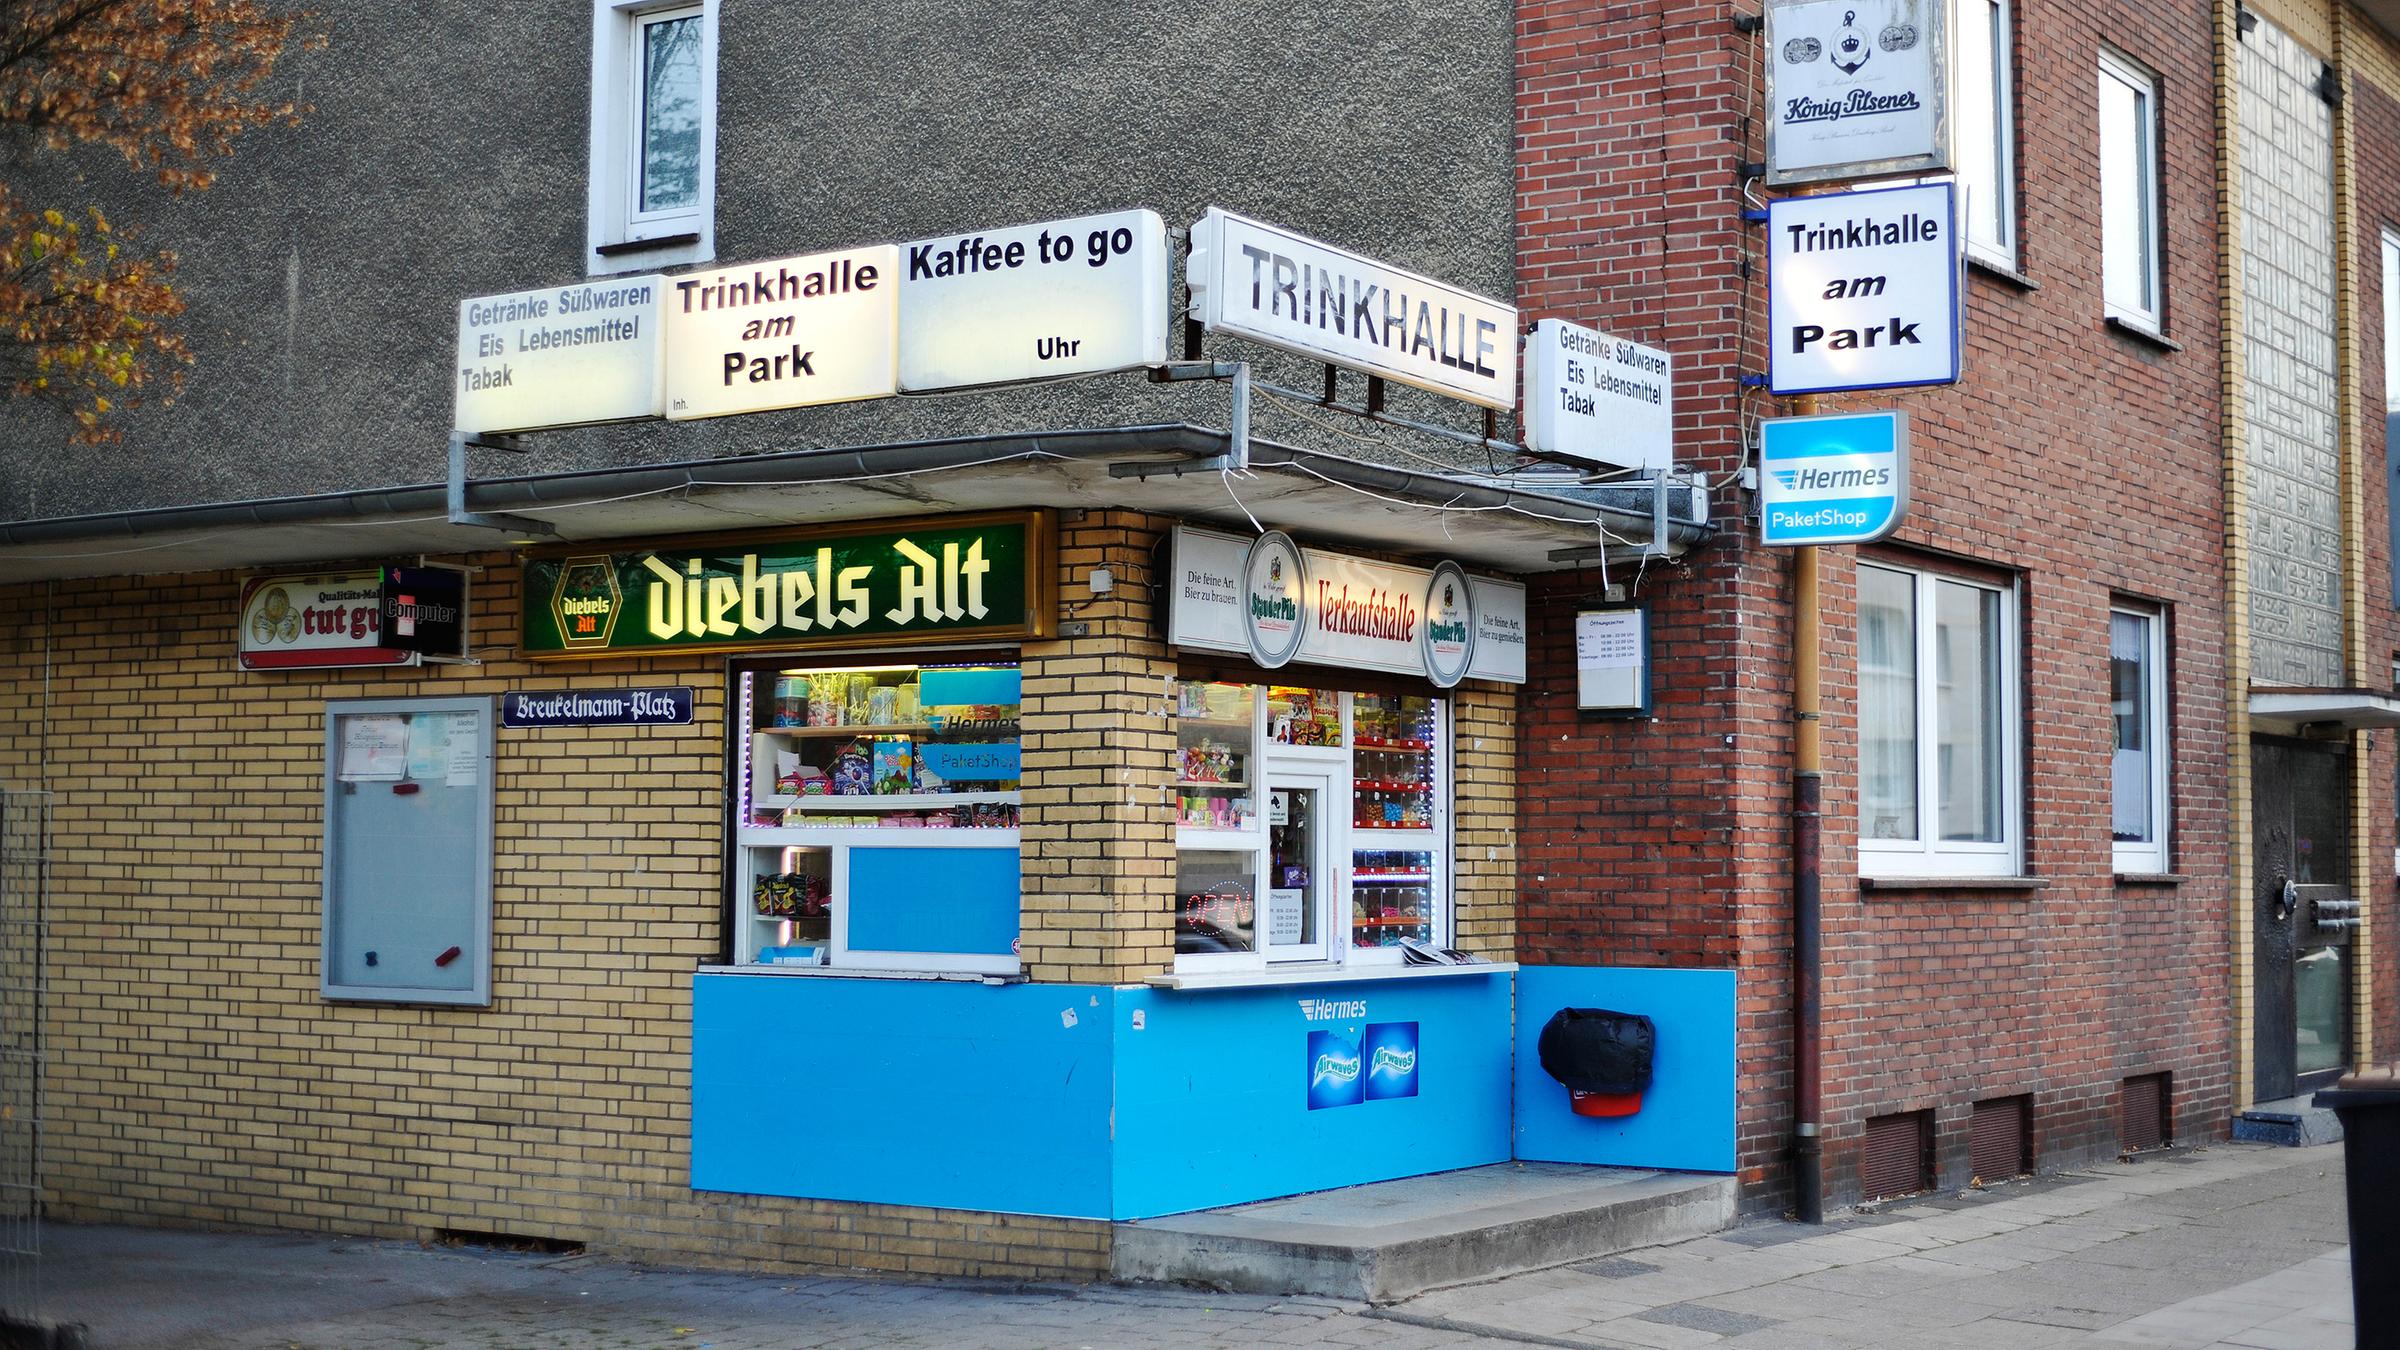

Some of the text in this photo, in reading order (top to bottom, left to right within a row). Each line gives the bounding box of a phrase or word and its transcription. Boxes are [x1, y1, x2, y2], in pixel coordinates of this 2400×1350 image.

[1784, 89, 1920, 121] König-Pilsener
[1788, 214, 1938, 253] Trinkhalle
[909, 226, 1135, 282] Kaffee to go
[676, 259, 879, 314] Trinkhalle
[1823, 274, 1887, 300] am
[469, 286, 651, 328] Getränke Süßwaren
[1242, 243, 1496, 379] TRINKHALLE
[479, 315, 640, 358] Eis Lebensmittel
[741, 315, 796, 342] am
[1792, 317, 1921, 354] Park
[1036, 336, 1081, 362] Uhr
[1560, 325, 1667, 377] Getränke Süßwaren
[462, 363, 513, 392] Tabak
[724, 344, 816, 386] Park
[1568, 359, 1662, 406] Eis Lebensmittel
[673, 398, 689, 412] Inh.
[1560, 387, 1595, 417] Tabak
[1800, 466, 1890, 491] Hermes
[1772, 509, 1867, 528] PaketShop
[885, 537, 990, 626] Alt
[1187, 570, 1202, 584] Die
[1203, 572, 1222, 587] feine
[319, 590, 380, 604] Qualitäts-Mal
[1184, 586, 1201, 600] Bier
[1201, 590, 1211, 601] zu
[303, 604, 348, 635] tut
[385, 597, 457, 624] Computer
[1281, 597, 1296, 621] Pils
[1318, 580, 1415, 642] Verkaufshalle
[1483, 614, 1494, 626] Die
[1494, 615, 1509, 629] feine
[576, 614, 596, 632] Alt
[1454, 621, 1466, 643] Pils
[1479, 627, 1491, 639] Bier
[1491, 632, 1498, 640] zu
[516, 691, 677, 721] Breukelmann-Platz
[947, 715, 1021, 735] Hermes
[942, 753, 1018, 771] PaketShop
[1186, 893, 1251, 926] OPEN
[1313, 998, 1367, 1021] Hermes
[1317, 1055, 1359, 1076] Airwaves
[1373, 1047, 1414, 1069] Airwaves
